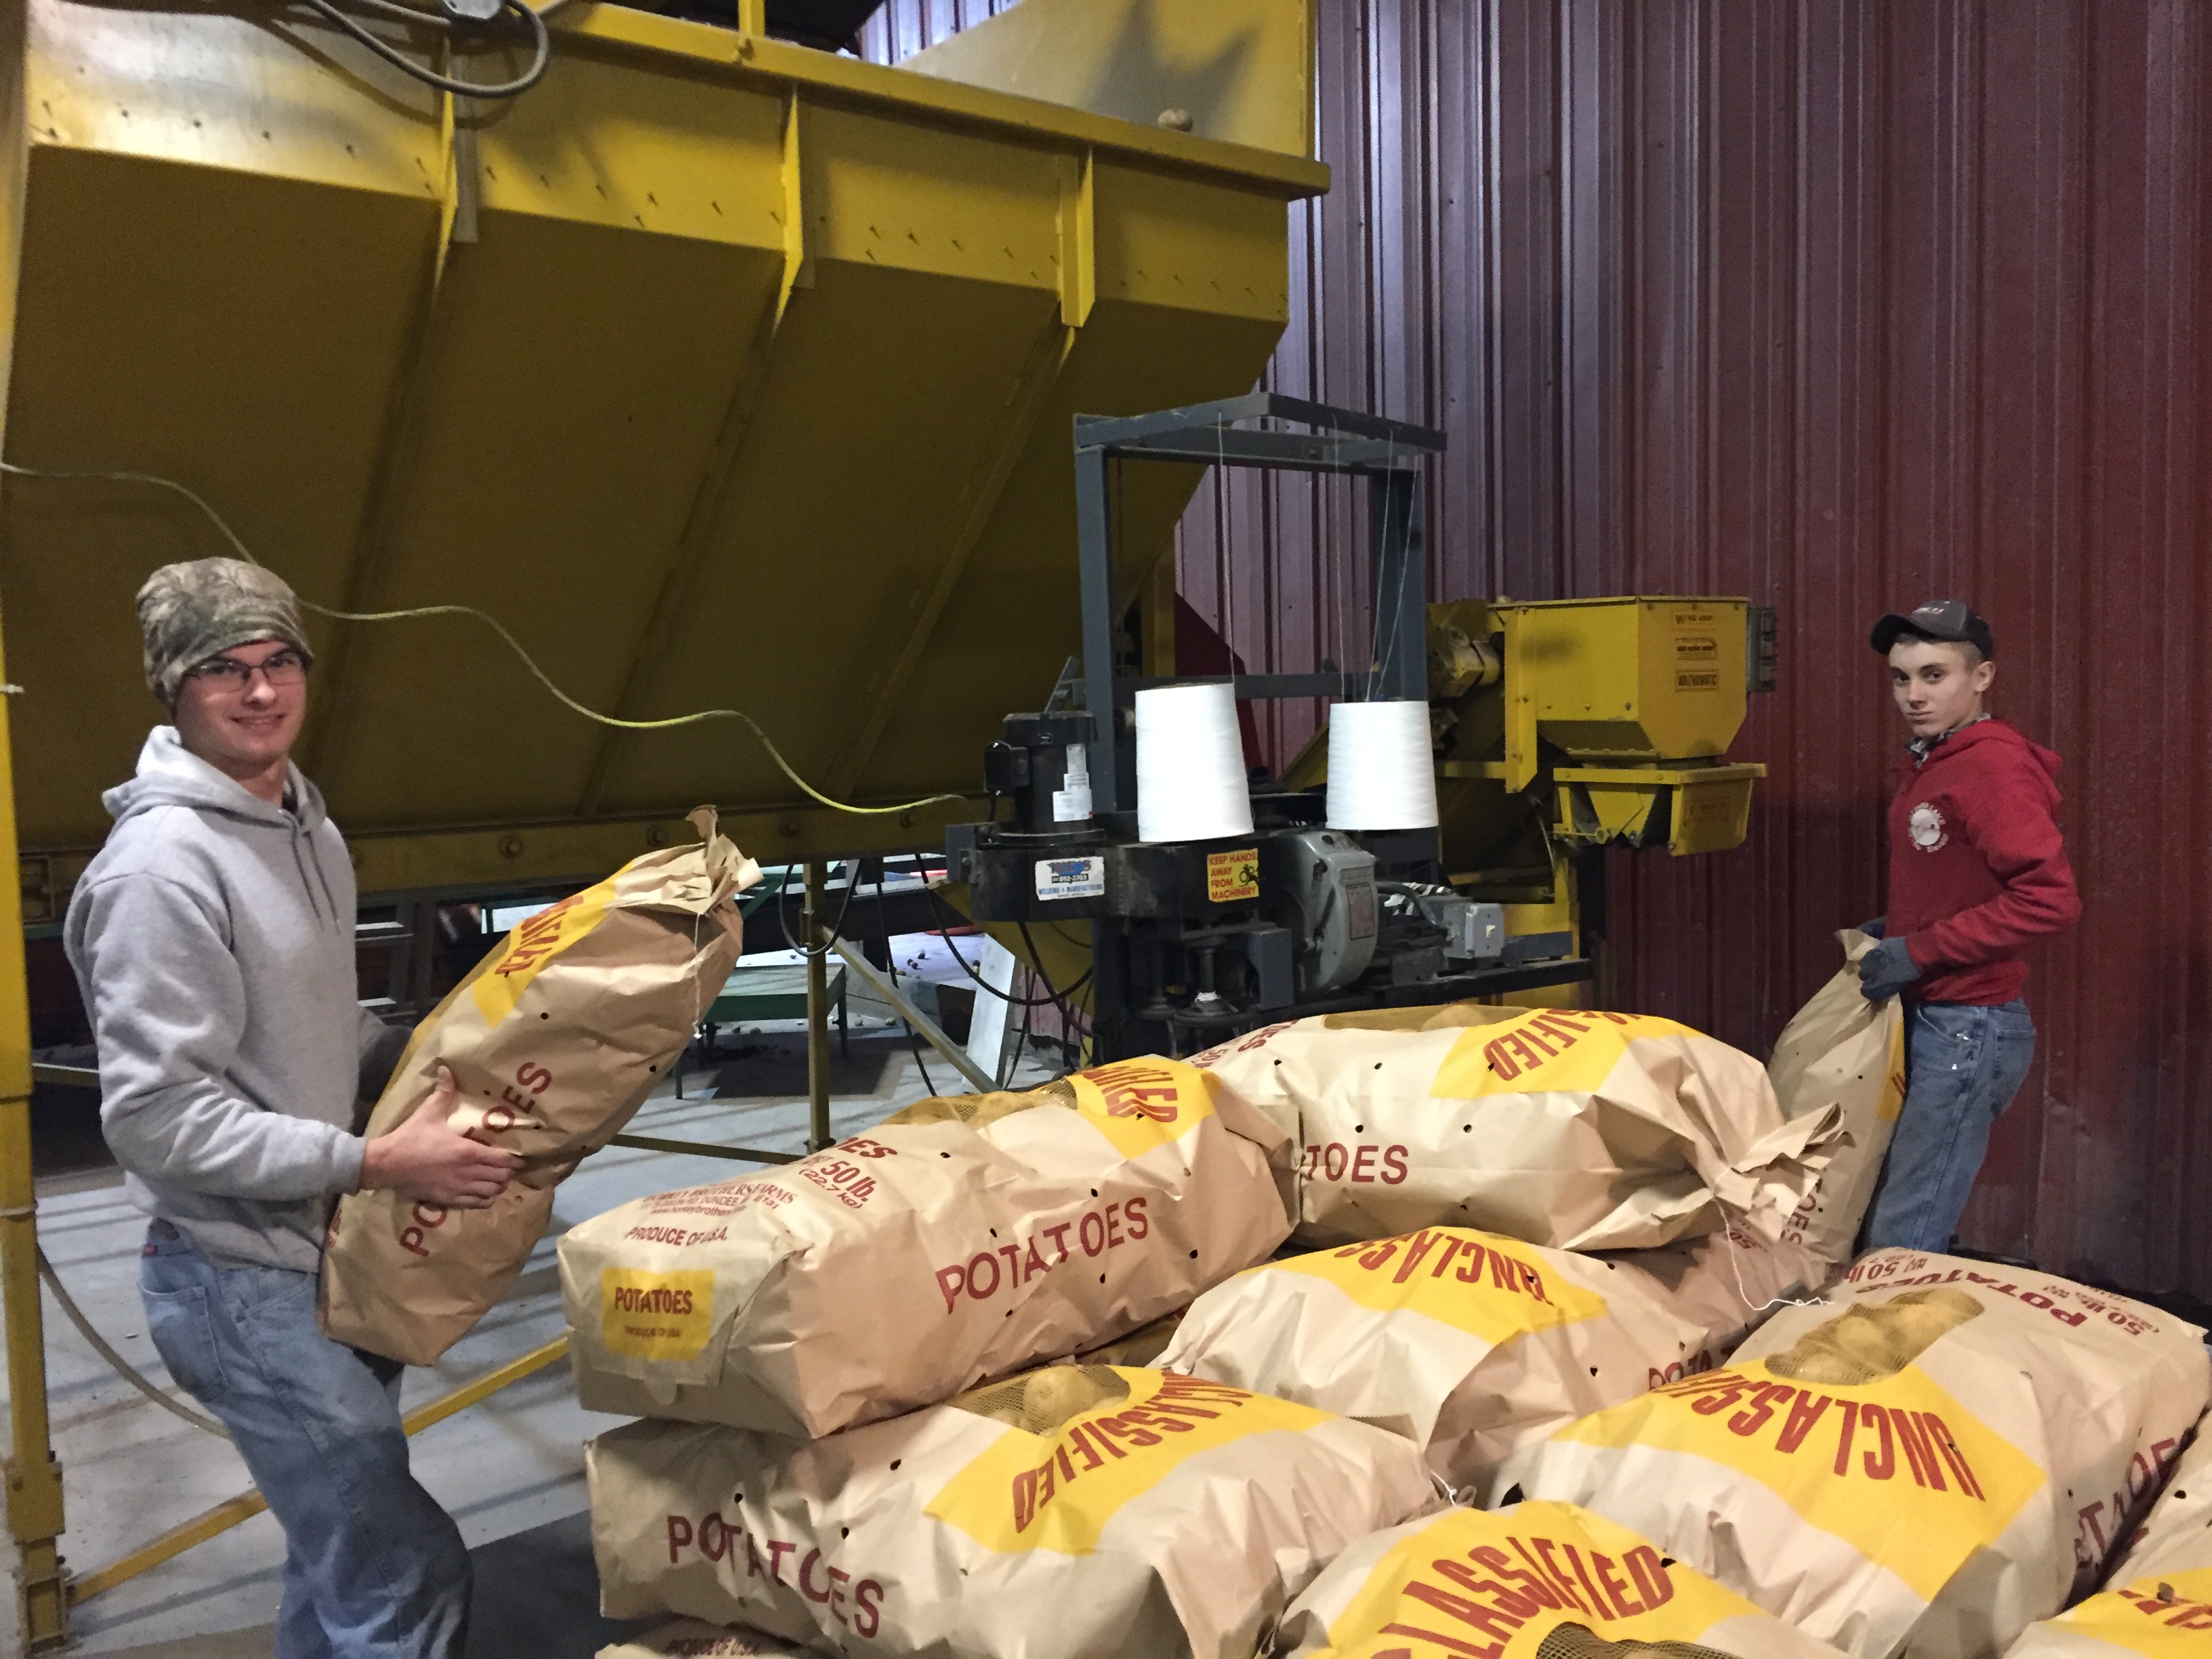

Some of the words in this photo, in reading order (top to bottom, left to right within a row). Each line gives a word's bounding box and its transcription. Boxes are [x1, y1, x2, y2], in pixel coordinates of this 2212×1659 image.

[1209, 856, 1227, 865] KEEP
[1230, 852, 1256, 863] HANDS
[1210, 867, 1232, 876] AWAY
[1211, 878, 1233, 888] FROM
[1211, 886, 1256, 900] MACHINERY
[799, 1169, 840, 1191] (22.7
[837, 1192, 863, 1208] kg)
[820, 1161, 860, 1183] 50
[846, 1176, 876, 1202] lb.
[625, 1226, 687, 1246] PRODUCE
[935, 1197, 1149, 1315] POTATOES
[1868, 1261, 1899, 1279] 50
[615, 1286, 693, 1315] POTATOES
[668, 1513, 884, 1638] POTATOES
[1372, 1536, 1675, 1659] LASSIFIED
